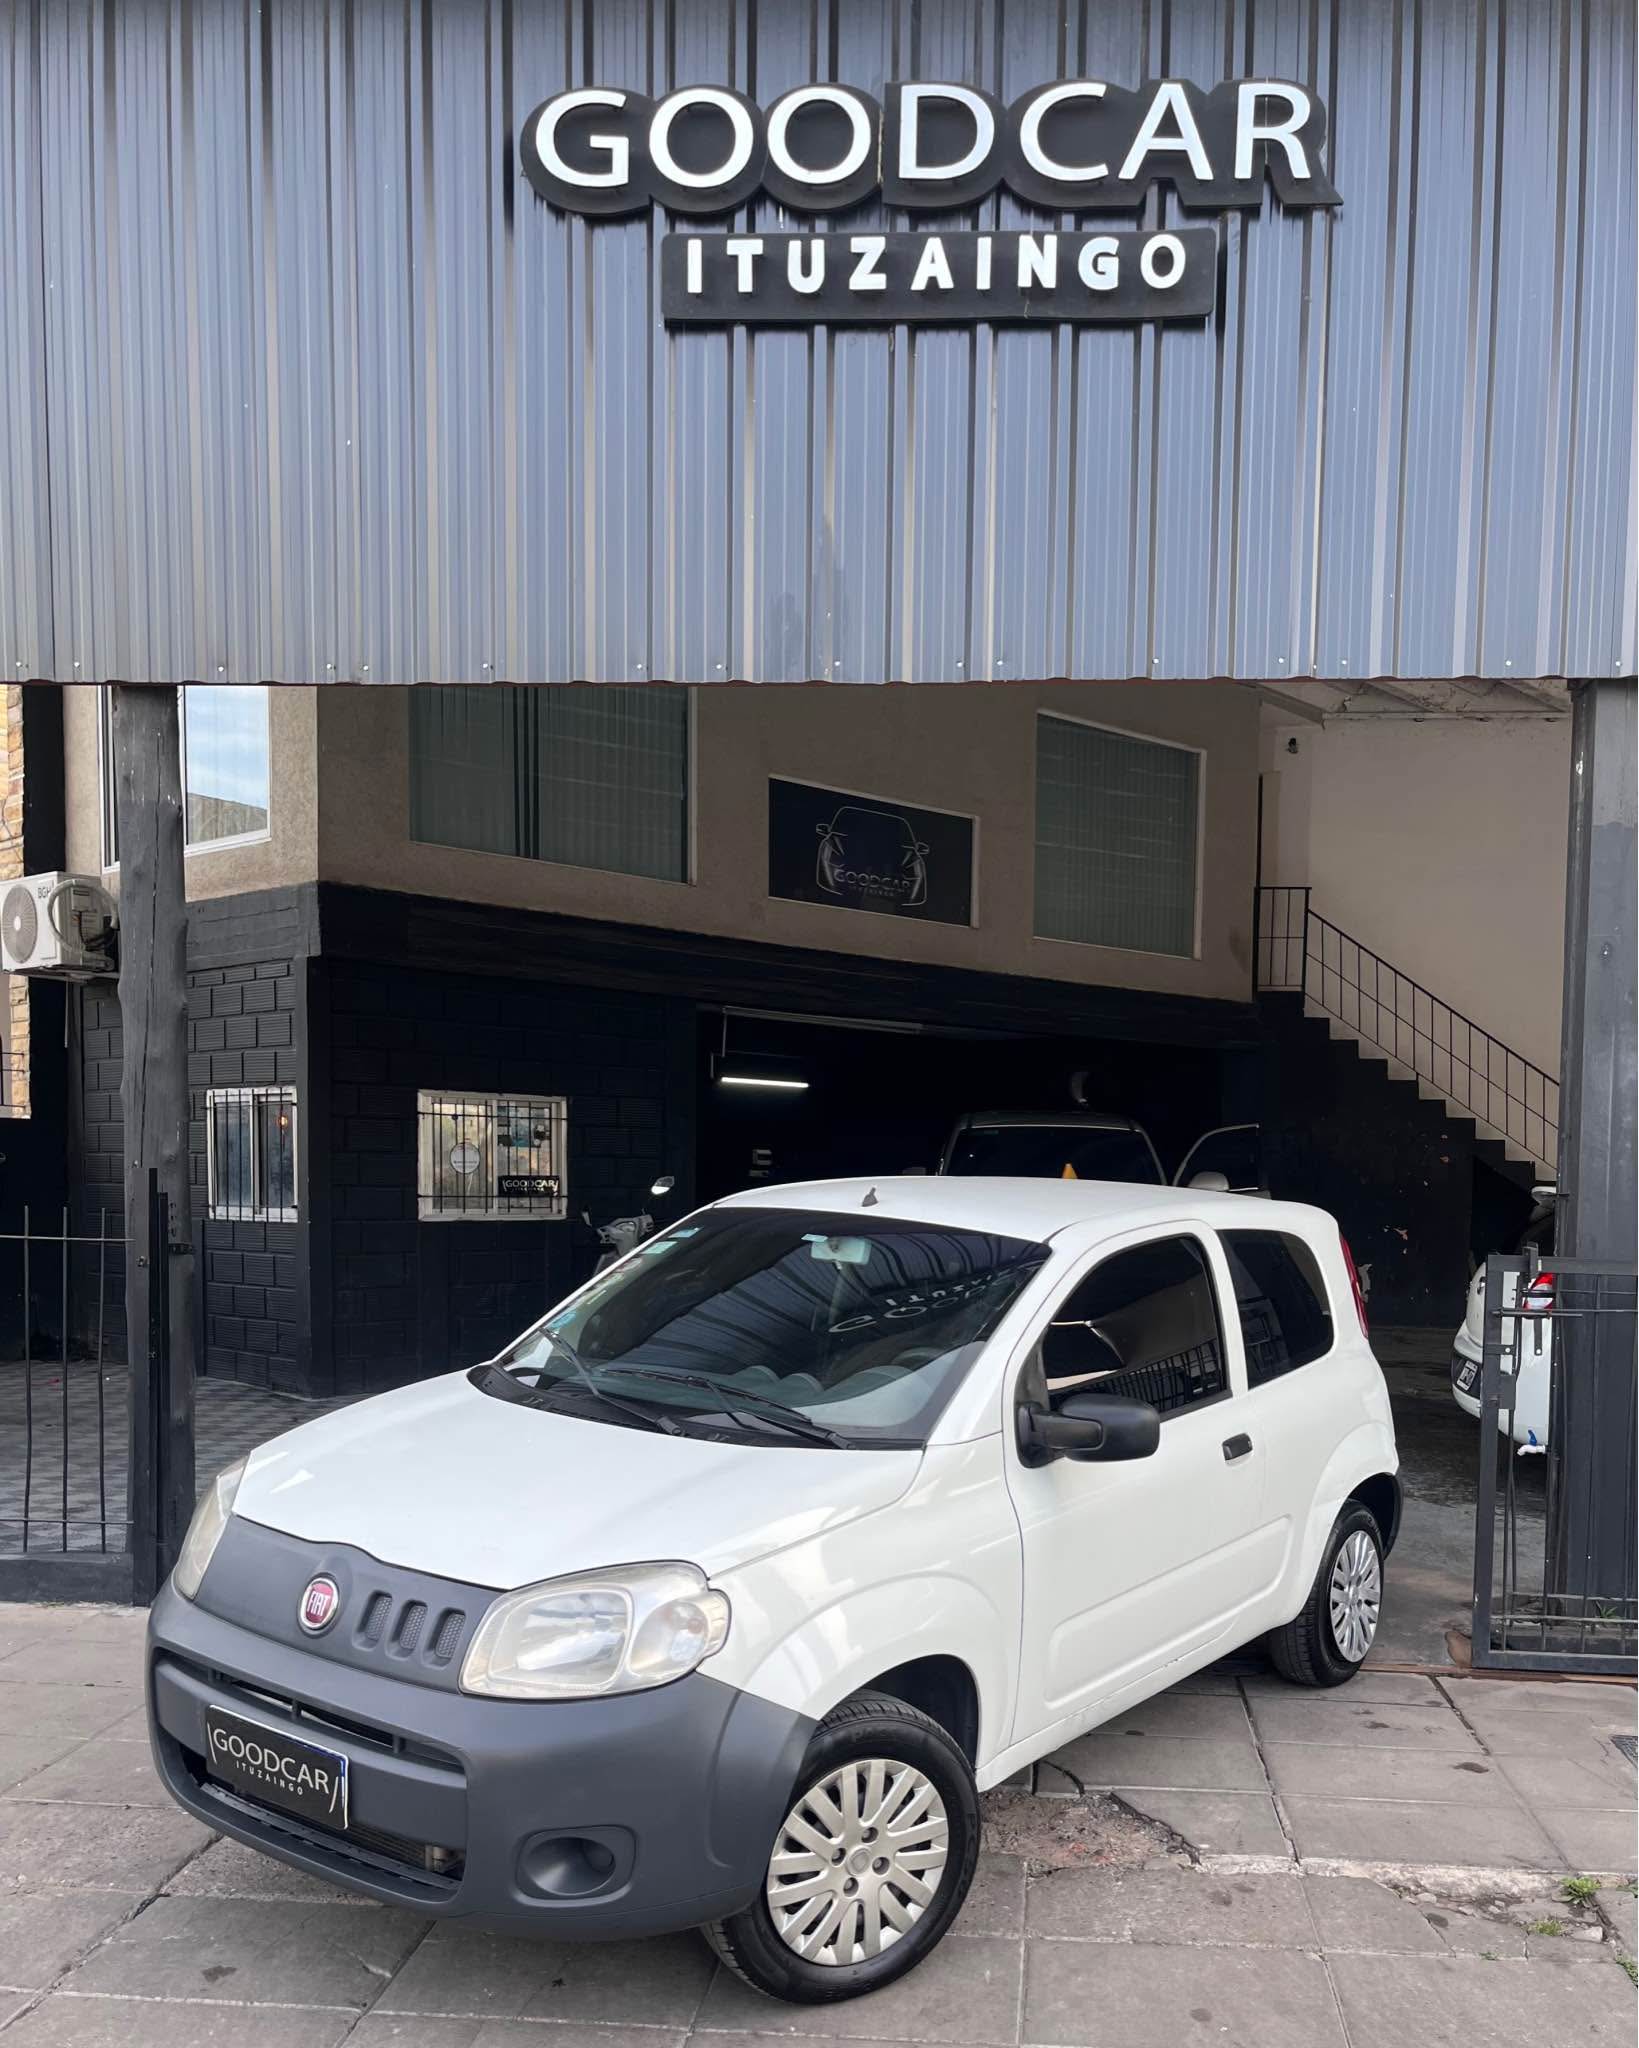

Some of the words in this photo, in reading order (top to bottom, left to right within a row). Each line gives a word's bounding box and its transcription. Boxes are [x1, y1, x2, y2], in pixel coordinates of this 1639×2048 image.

[535, 82, 1312, 188] GOODCAR
[687, 235, 1187, 294] ITUZAINGO
[833, 868, 912, 891] GOODCAR
[505, 1179, 554, 1190] GOODCAR
[306, 1590, 331, 1617] FIAT
[213, 1728, 330, 1795] GOODCAR
[235, 1760, 304, 1796] ITUZAINGO
